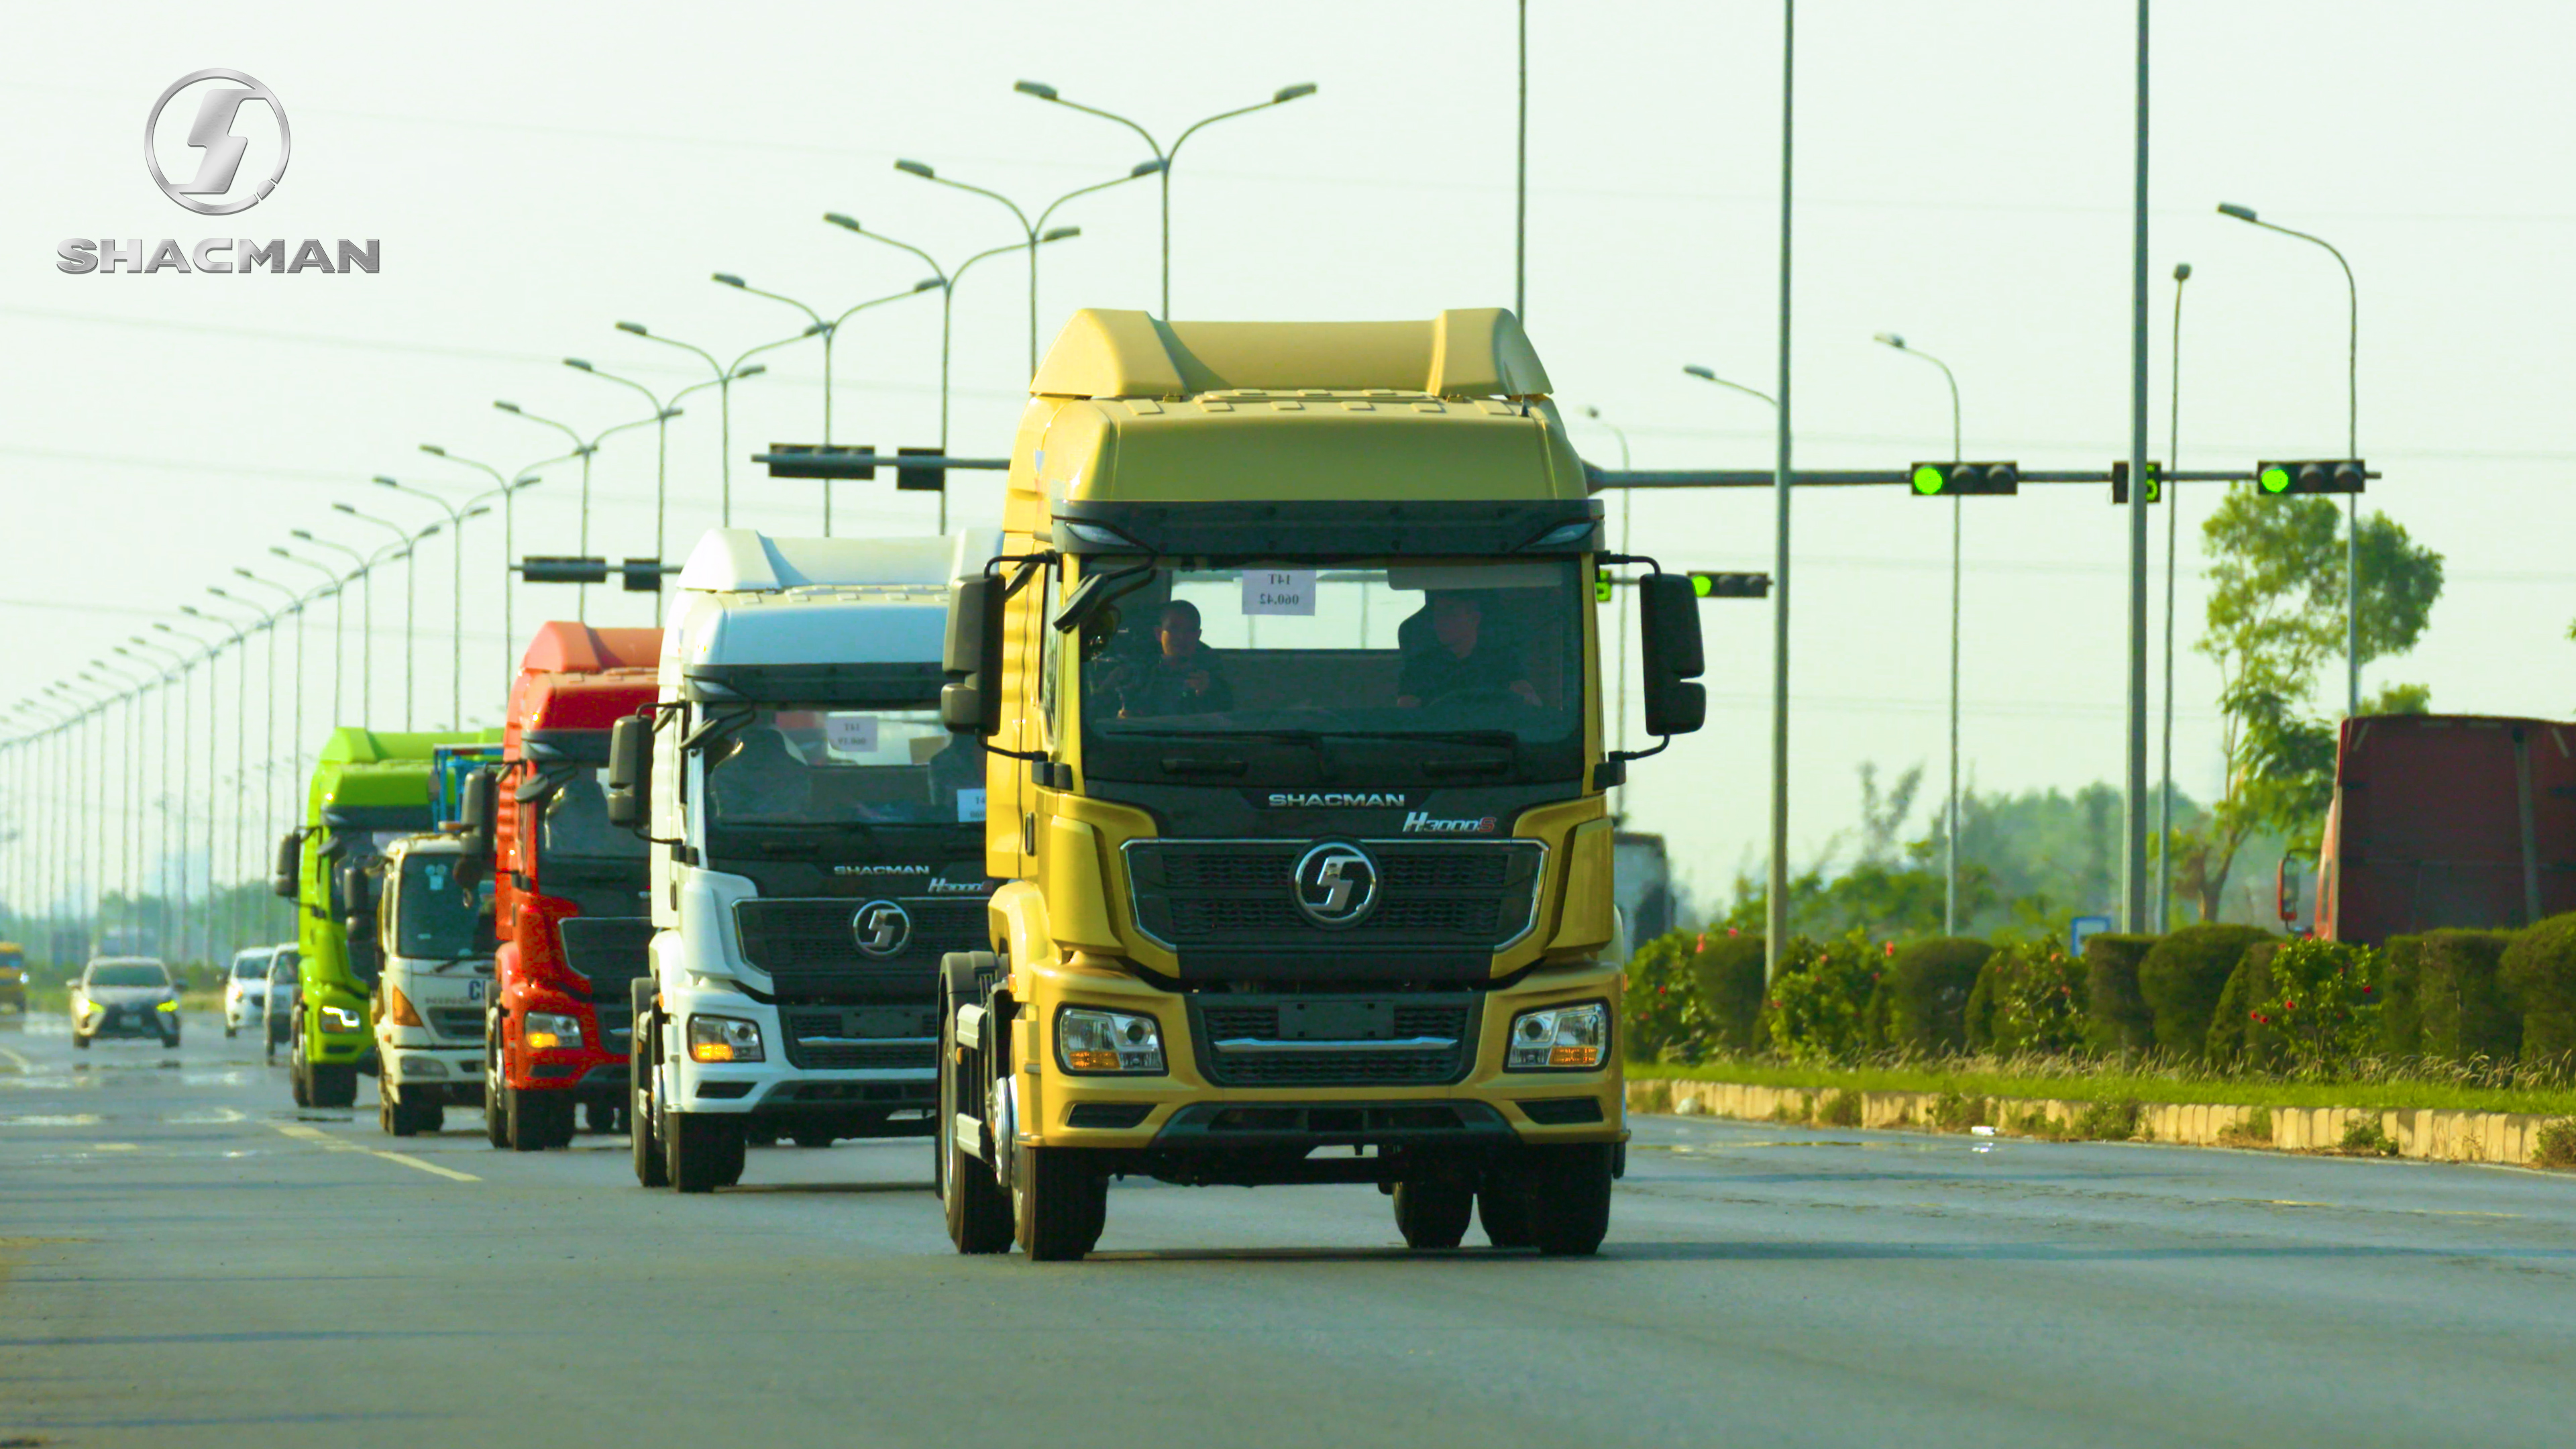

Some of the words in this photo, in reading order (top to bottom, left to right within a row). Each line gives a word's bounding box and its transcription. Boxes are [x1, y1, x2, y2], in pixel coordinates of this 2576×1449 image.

[1269, 794, 1405, 807] SHACMAN
[1403, 812, 1497, 832] H3000S
[834, 865, 930, 875] SHACMAN
